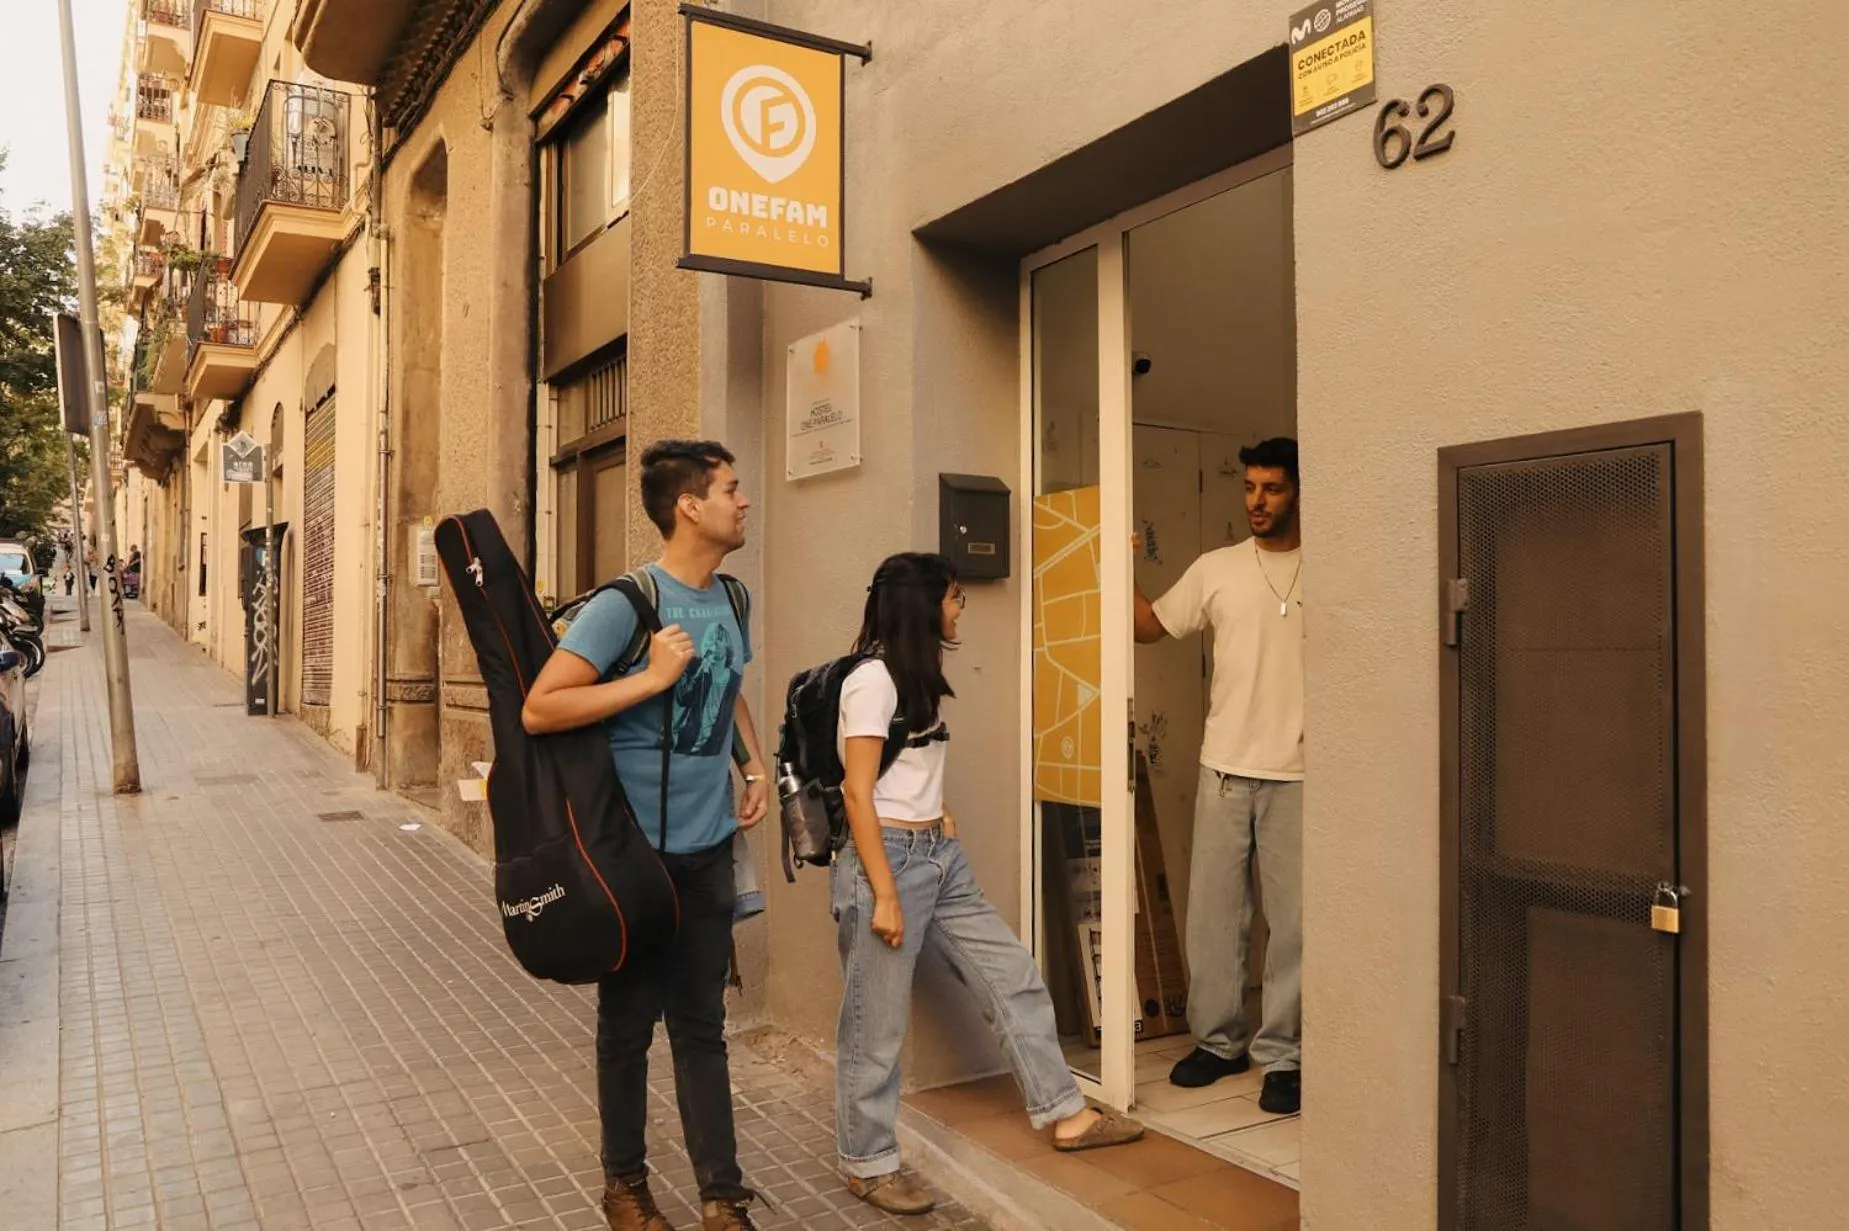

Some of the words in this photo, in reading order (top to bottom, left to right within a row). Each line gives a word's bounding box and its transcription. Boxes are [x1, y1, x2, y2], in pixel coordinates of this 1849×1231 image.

[1298, 29, 1366, 70] CONECTADA
[1373, 83, 1456, 169] 62
[708, 186, 828, 228] ONEFAM
[706, 216, 830, 248] PARALELO
